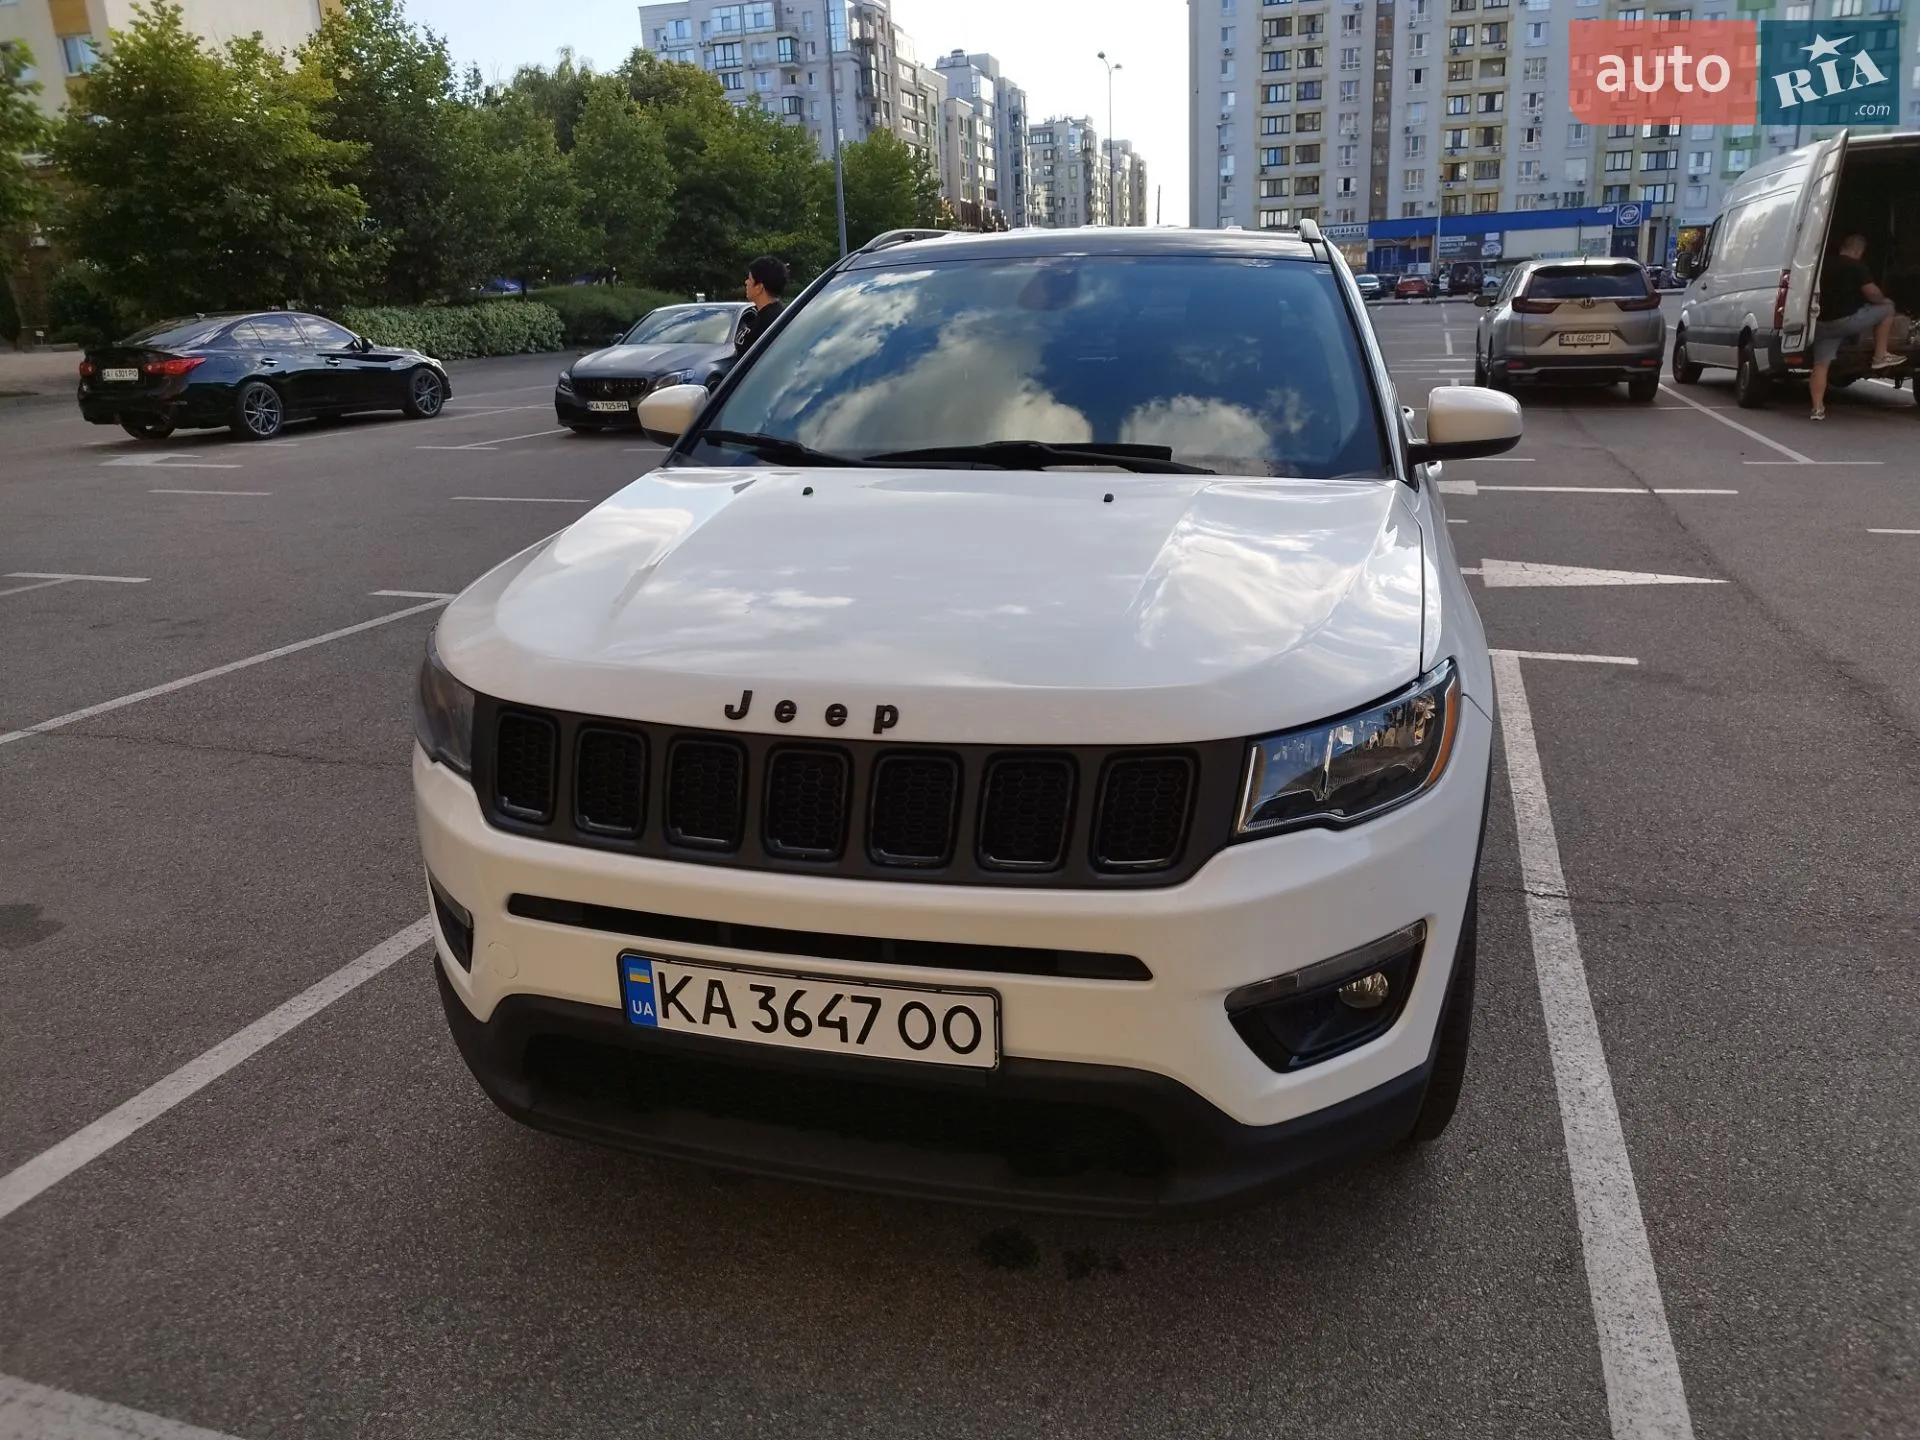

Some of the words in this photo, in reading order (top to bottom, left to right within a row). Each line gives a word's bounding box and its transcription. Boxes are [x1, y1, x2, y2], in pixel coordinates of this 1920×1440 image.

[724, 689, 900, 735] Jeep
[632, 999, 655, 1018] UA
[657, 971, 737, 1030] KA
[749, 983, 882, 1045] 3647
[897, 1000, 982, 1055] OO
